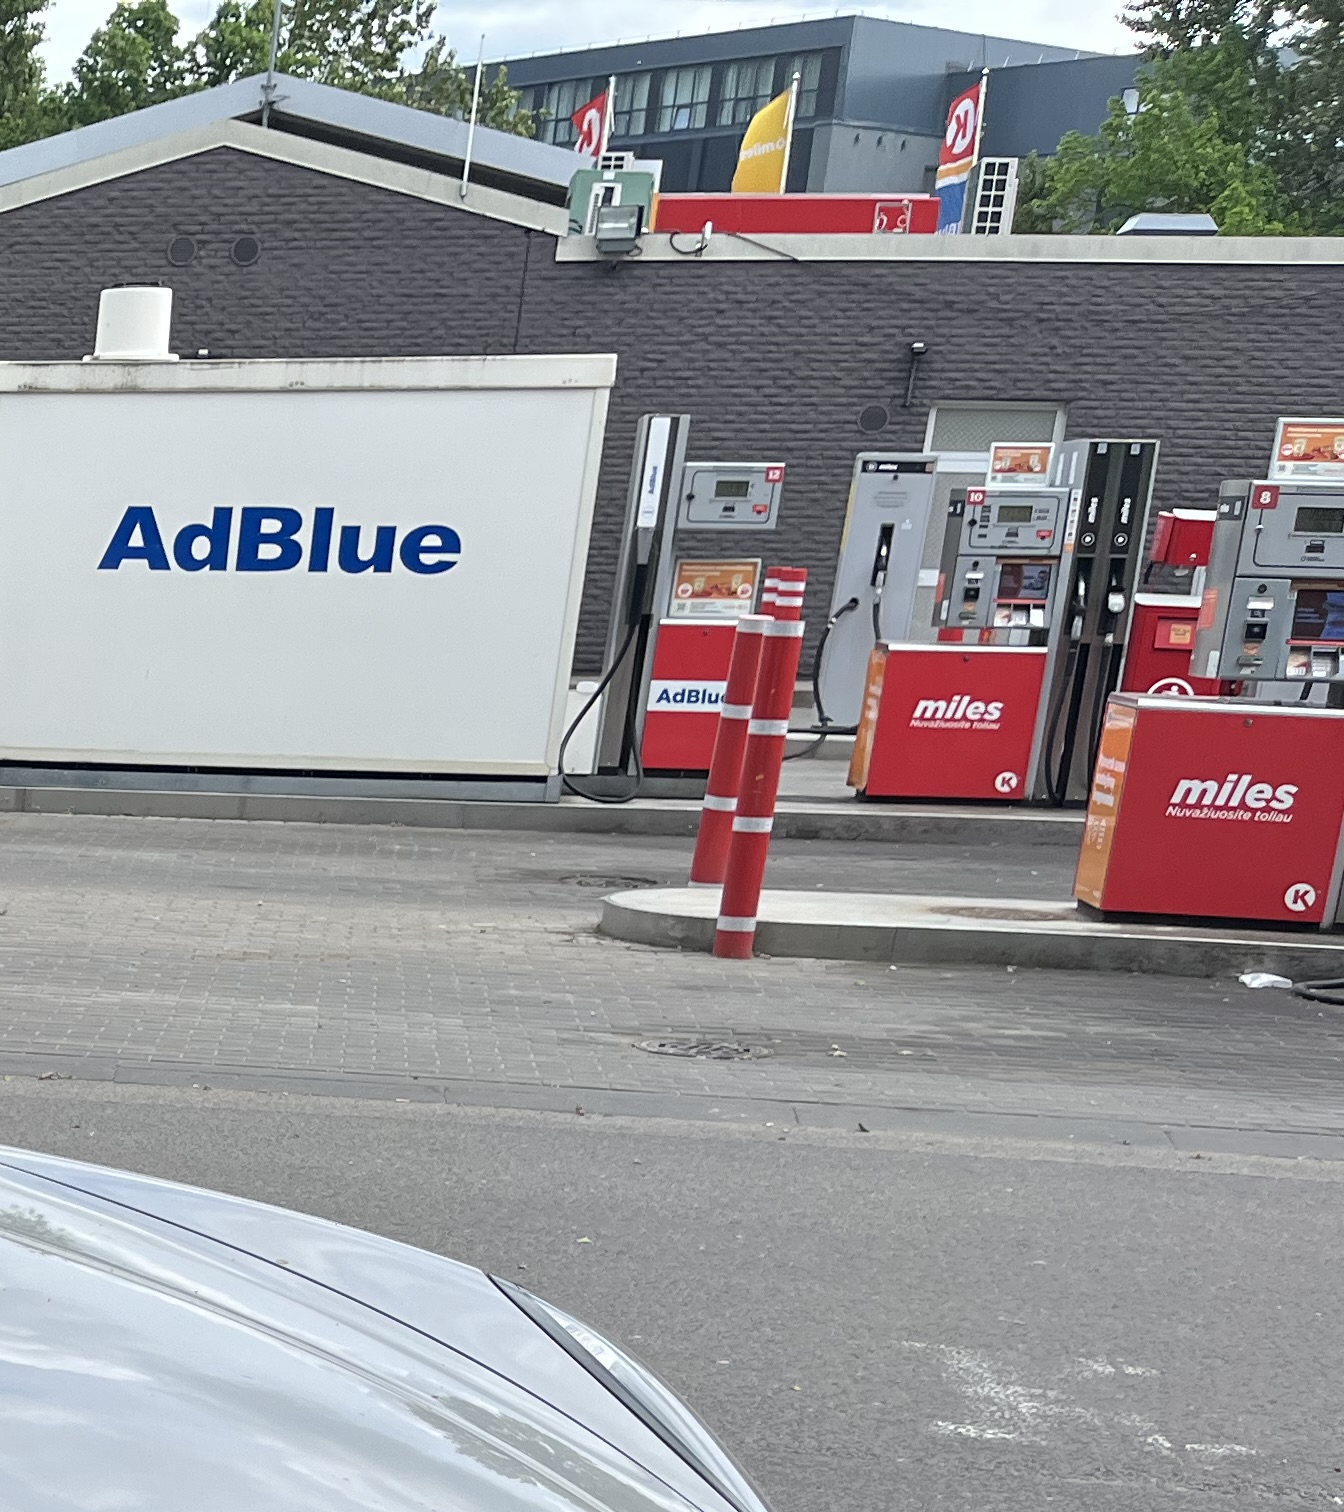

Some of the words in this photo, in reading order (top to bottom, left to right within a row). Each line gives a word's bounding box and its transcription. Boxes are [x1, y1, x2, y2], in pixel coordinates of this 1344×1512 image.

[768, 470, 781, 480] 12
[968, 492, 984, 502] 10
[1259, 490, 1272, 505] 8
[97, 505, 462, 575] AdBlue
[912, 694, 1004, 721] miles
[1169, 773, 1299, 811] miles
[1165, 805, 1251, 822] Nuvažiuosite
[1254, 808, 1293, 823] toliau
